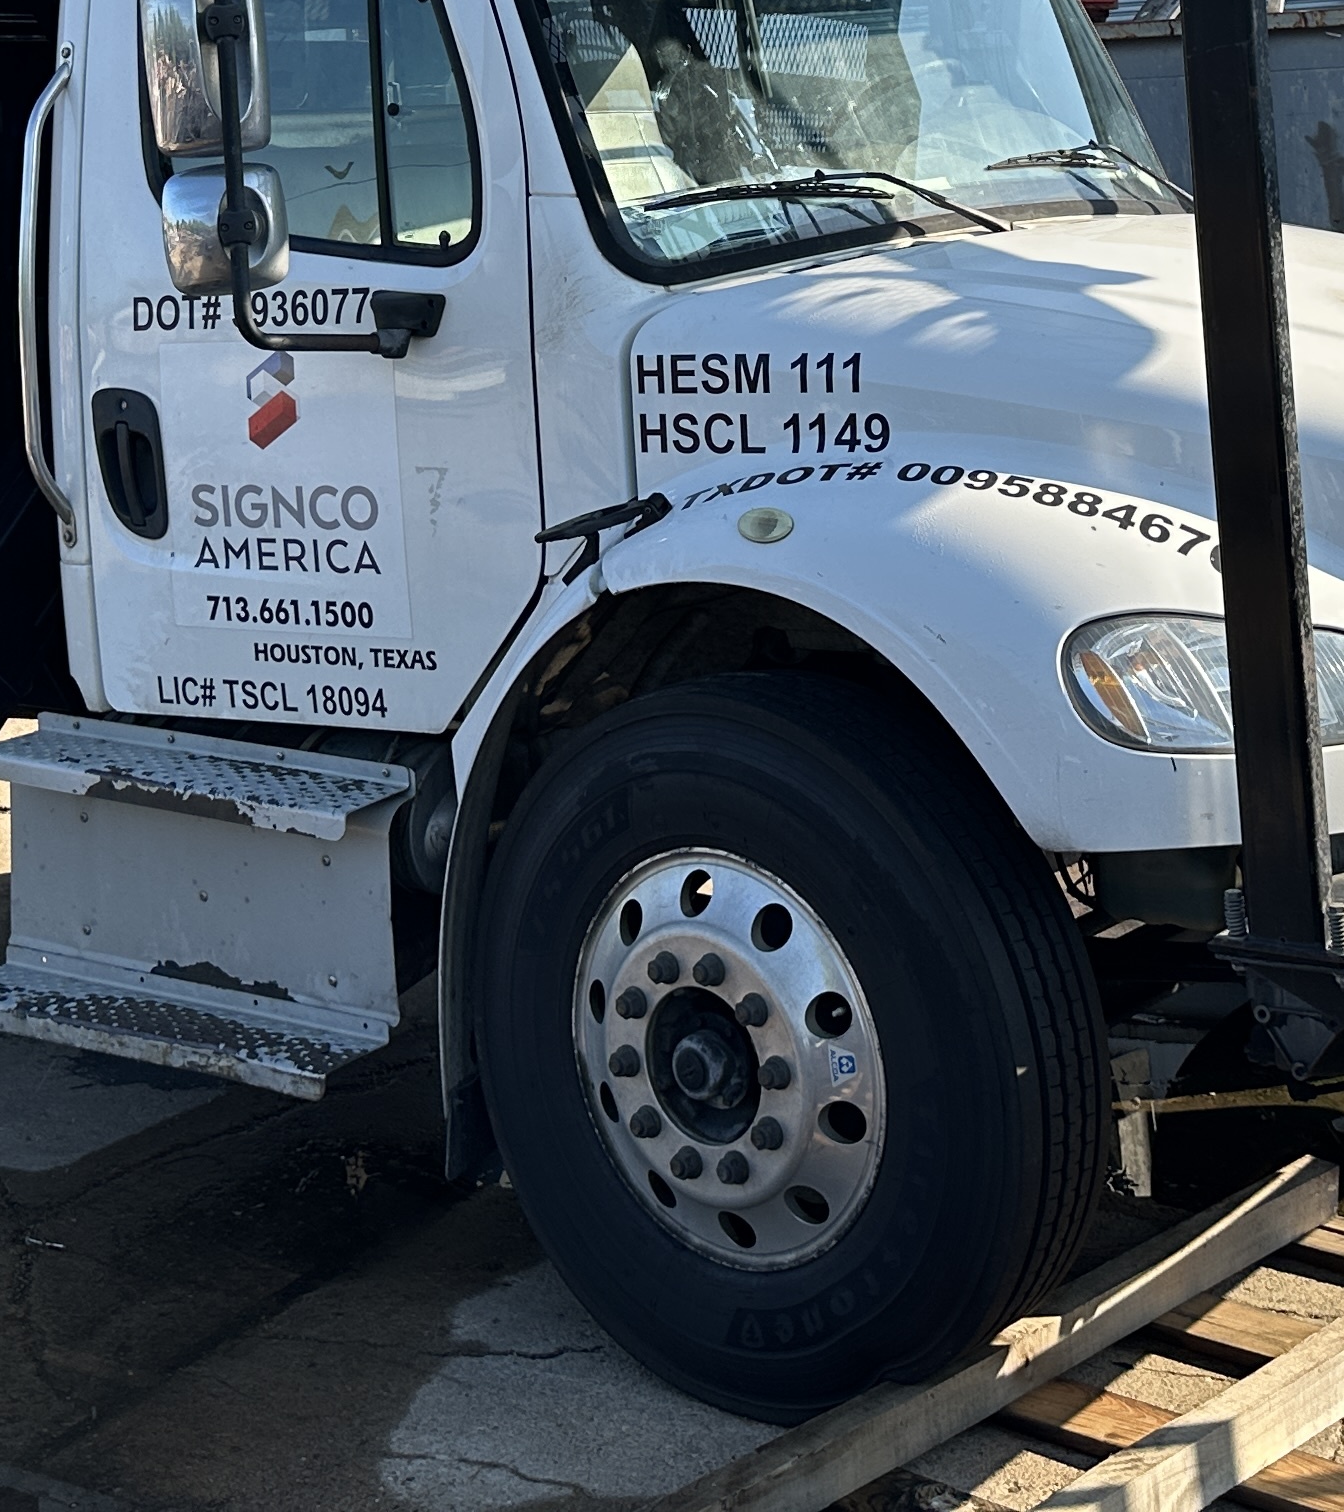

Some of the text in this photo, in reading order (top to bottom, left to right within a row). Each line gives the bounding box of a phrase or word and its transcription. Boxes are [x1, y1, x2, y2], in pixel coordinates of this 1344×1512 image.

[132, 287, 371, 332] DOT# 936077
[636, 352, 862, 394] HESM 111
[639, 412, 891, 454] HSCL 1149
[191, 484, 379, 531] SIGNCO
[681, 461, 1223, 574] TXDOT# 009588467
[194, 536, 382, 575] AMERICA
[206, 595, 374, 629] 713.661.1500
[253, 642, 438, 671] HOUSTON, TEXAS
[157, 675, 388, 718] LIC# TSCL 18094
